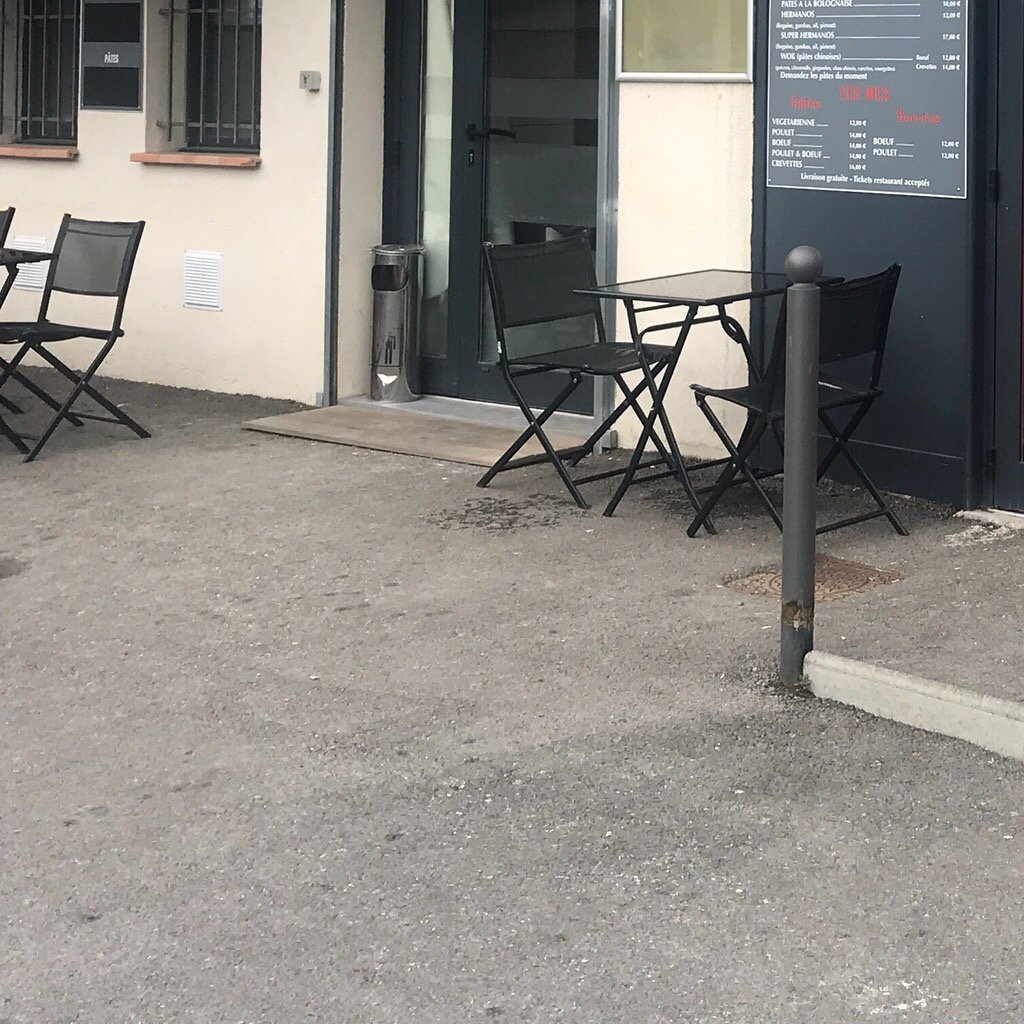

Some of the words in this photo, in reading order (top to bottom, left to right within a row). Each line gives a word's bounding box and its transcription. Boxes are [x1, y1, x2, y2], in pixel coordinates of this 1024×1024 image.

[780, 72, 808, 80] Demandez
[819, 72, 834, 81] pâtes
[772, 119, 815, 127] VEGETARIENNE
[772, 160, 802, 168] CREVETTES
[854, 176, 872, 184] Tickets
[874, 177, 903, 185] restaurant
[904, 178, 930, 187] acceptés
